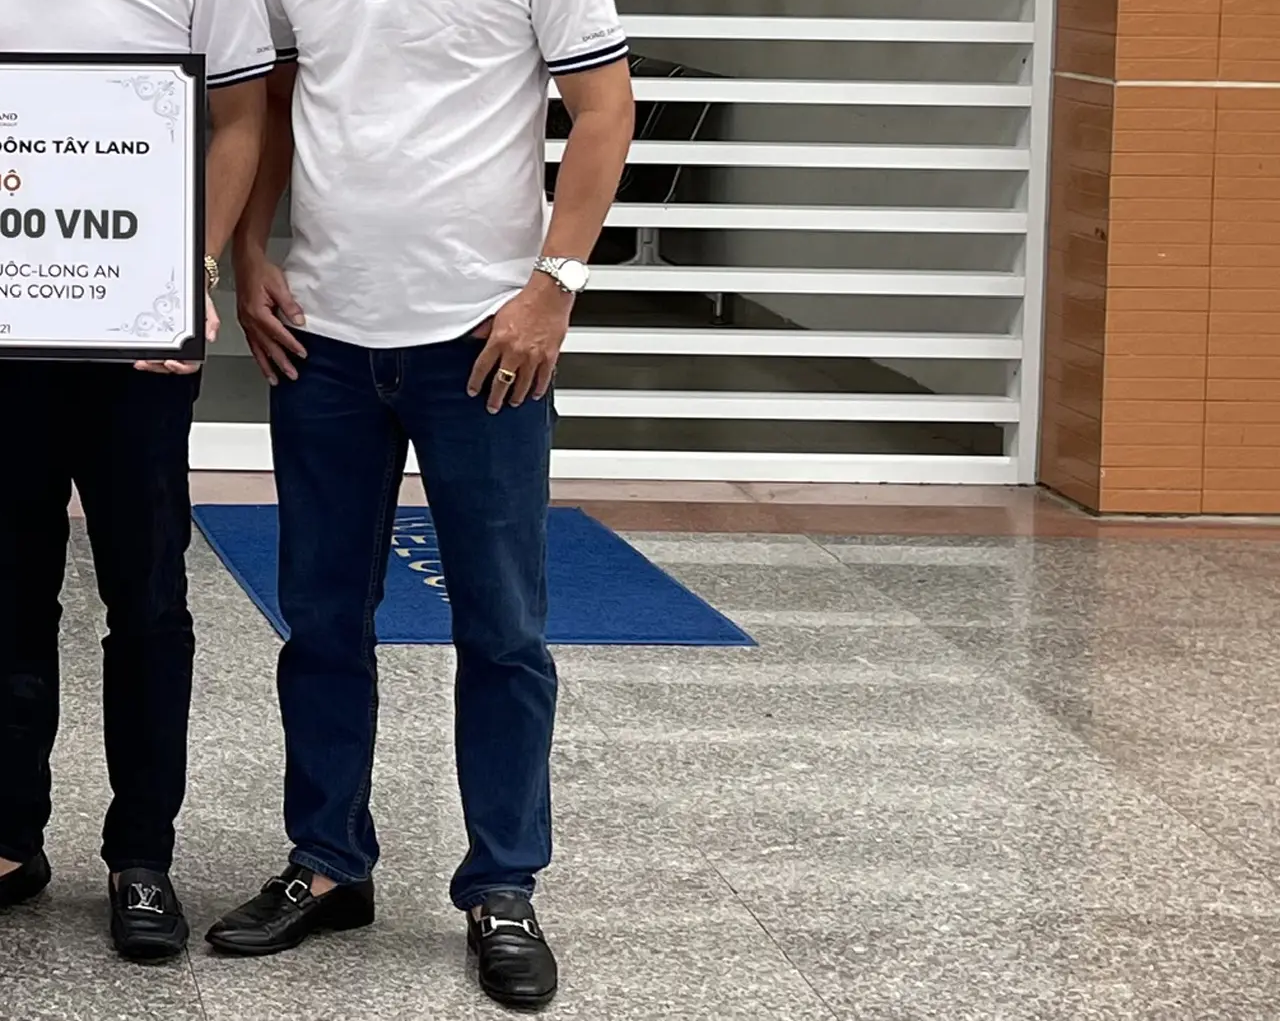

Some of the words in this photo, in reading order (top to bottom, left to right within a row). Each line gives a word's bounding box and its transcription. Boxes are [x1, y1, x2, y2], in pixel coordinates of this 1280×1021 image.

[52, 136, 90, 154] TÂY
[95, 140, 150, 155] LAND
[54, 208, 138, 240] VND
[94, 264, 120, 279] AN
[27, 284, 85, 299] COVID
[89, 285, 107, 300] 19
